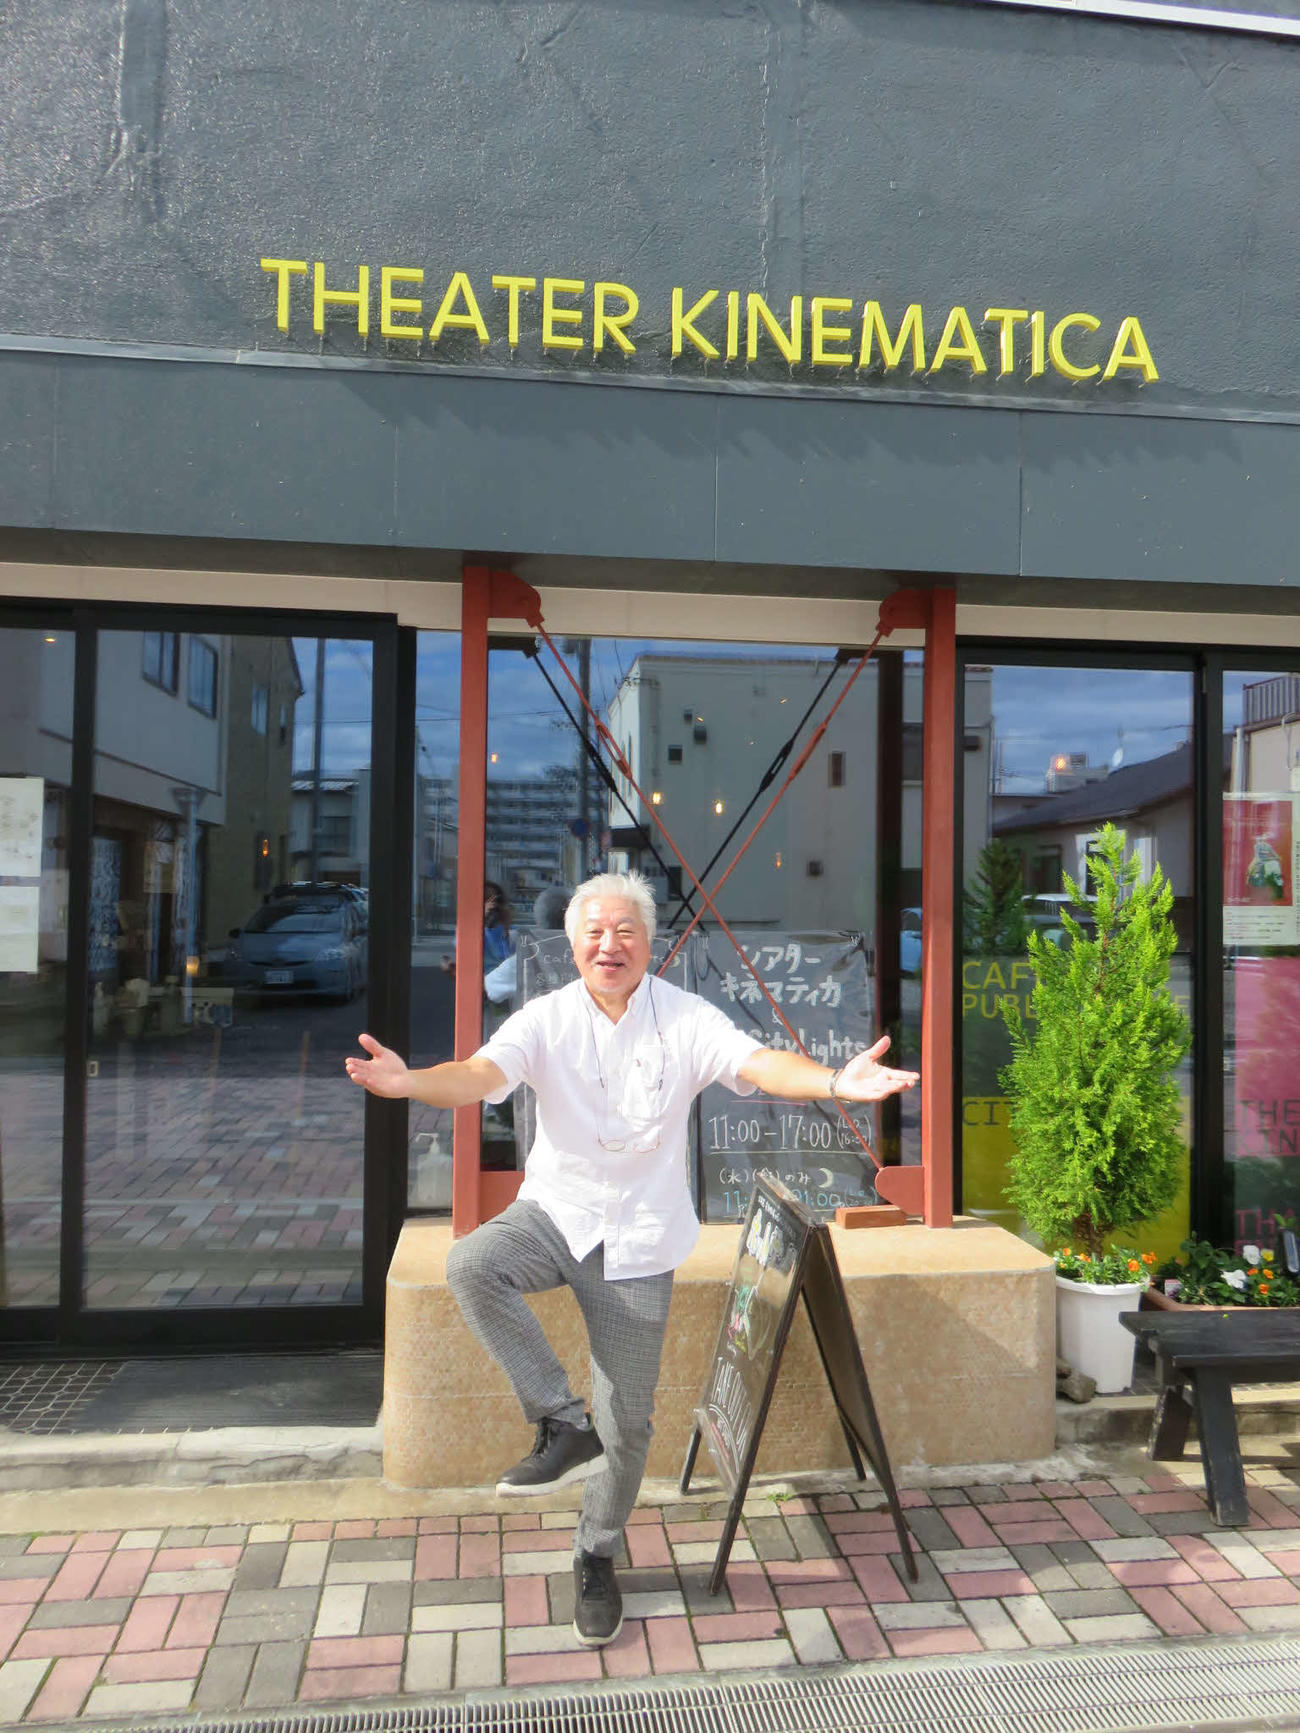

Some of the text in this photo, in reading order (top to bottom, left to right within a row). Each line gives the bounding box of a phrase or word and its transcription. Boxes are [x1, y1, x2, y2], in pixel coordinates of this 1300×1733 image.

[260, 258, 1158, 382] THEATER KINEMATICA
[737, 943, 821, 974] シアター
[720, 972, 841, 1008] キネマティカ
[962, 962, 1036, 990] CAF
[962, 993, 1038, 1018] PUBL
